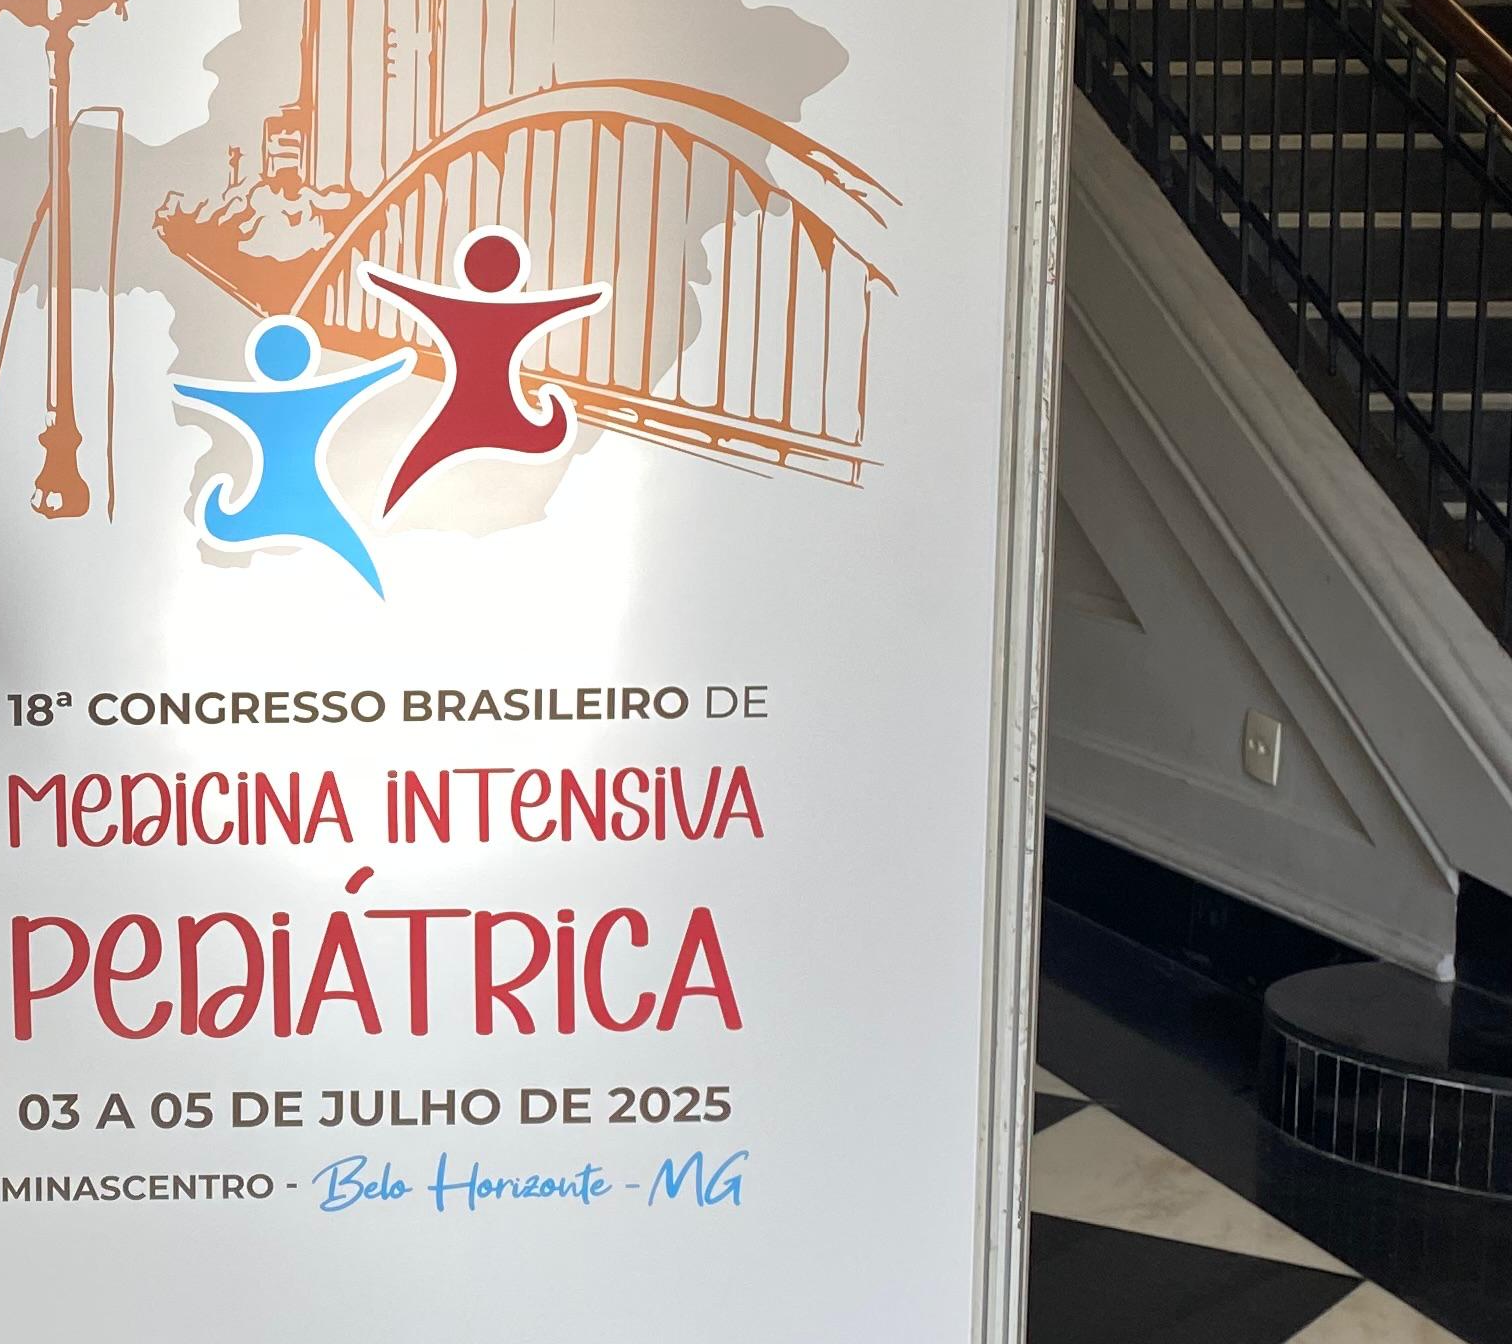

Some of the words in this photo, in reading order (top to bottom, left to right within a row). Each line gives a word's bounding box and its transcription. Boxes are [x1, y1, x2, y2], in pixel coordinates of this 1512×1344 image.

[88, 690, 386, 727] CONGRESSO
[403, 686, 690, 723] BRASILEIRO
[705, 684, 770, 720] DE
[18, 1093, 80, 1131] 03
[96, 1093, 136, 1130] A
[150, 1091, 214, 1130] 05
[232, 1091, 304, 1128] DE
[318, 1088, 502, 1128] JULHO
[520, 1087, 593, 1125] DE
[608, 1086, 733, 1124] 2025
[1, 1173, 275, 1203] MINASCENTRO
[312, 1155, 411, 1213] Belo
[427, 1152, 613, 1214] Horizonte
[647, 1150, 751, 1209] MG
